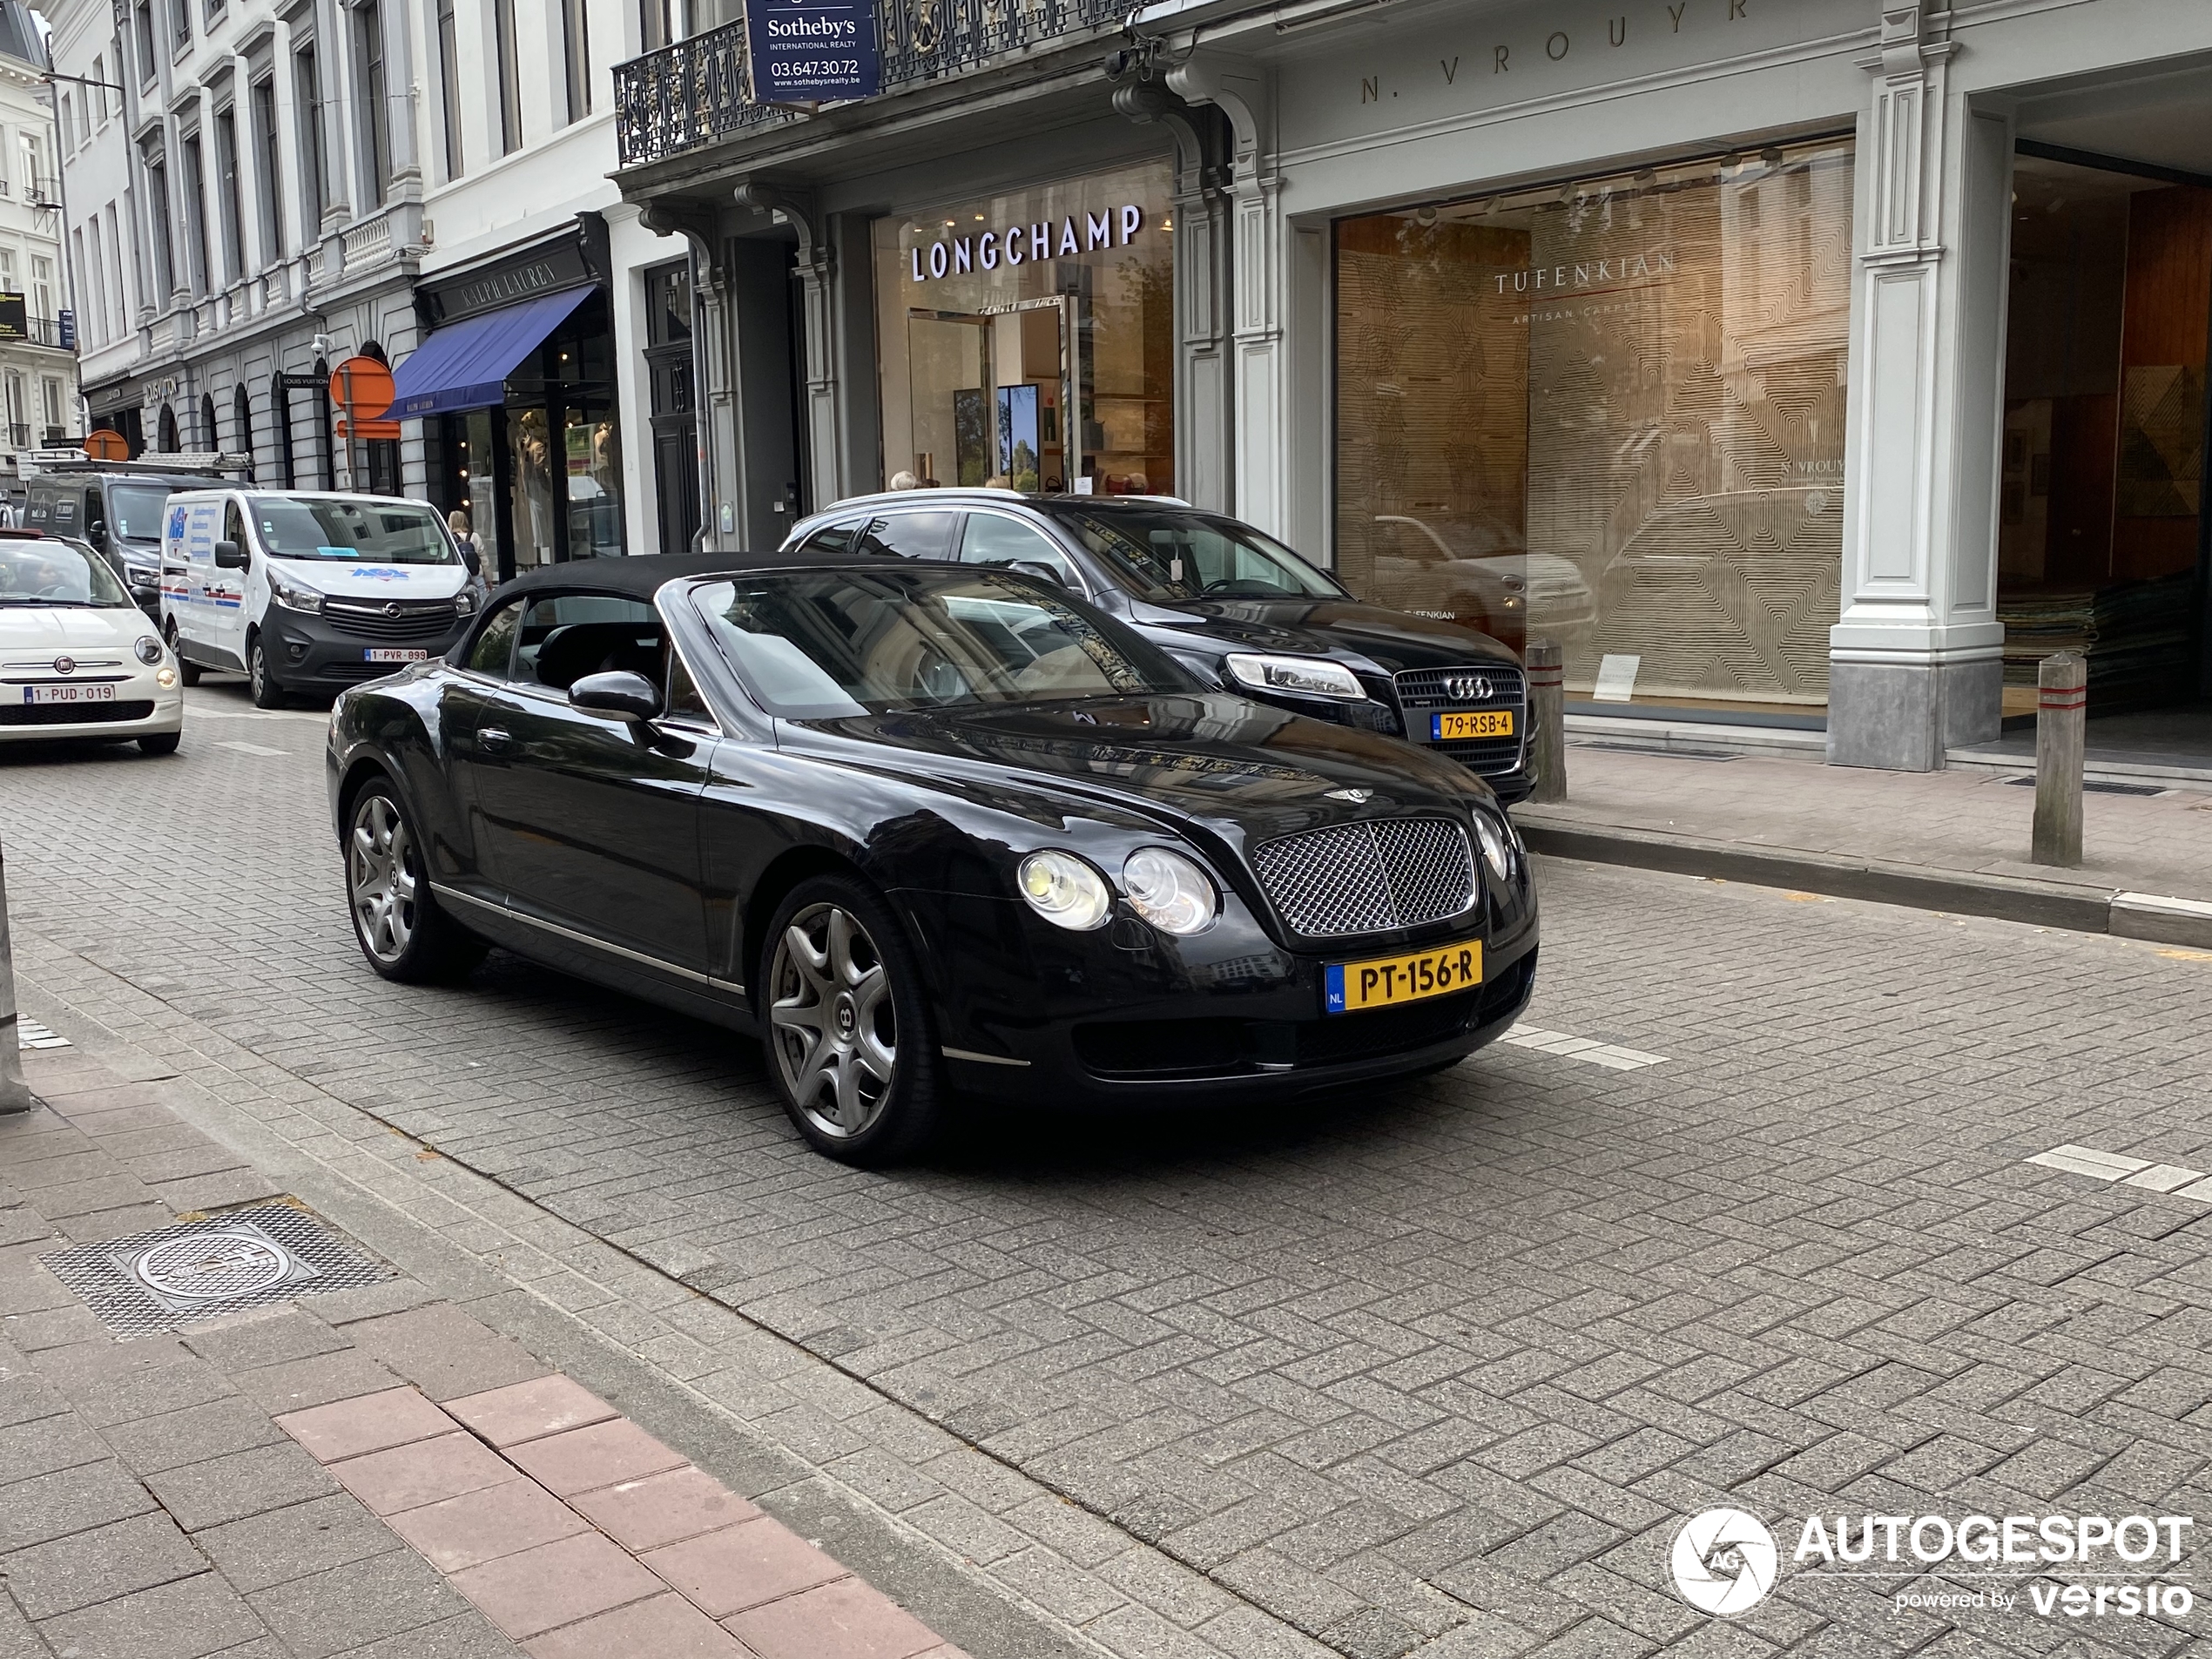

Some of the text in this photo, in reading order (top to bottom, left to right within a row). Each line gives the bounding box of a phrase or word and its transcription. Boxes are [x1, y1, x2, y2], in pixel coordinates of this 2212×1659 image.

[767, 16, 856, 39] Sotheby's
[769, 41, 829, 51] INTERNATIONAL
[1361, 0, 1747, 105] N. VROUYR
[771, 59, 860, 77] 03.647.30.72
[773, 76, 860, 86] www.sothebysrealty.be
[912, 205, 1142, 282] LONGCHAMP
[1494, 252, 1675, 294] TUFENKIAN
[461, 262, 556, 307] RALPH LAUREN
[1512, 309, 1574, 325] ARTISAN
[373, 650, 427, 661] 1-PVR-899
[36, 687, 111, 701] 1-PUD-019
[1445, 714, 1508, 736] 79-RSB-4
[1330, 949, 1473, 1004] NL PT-156-R
